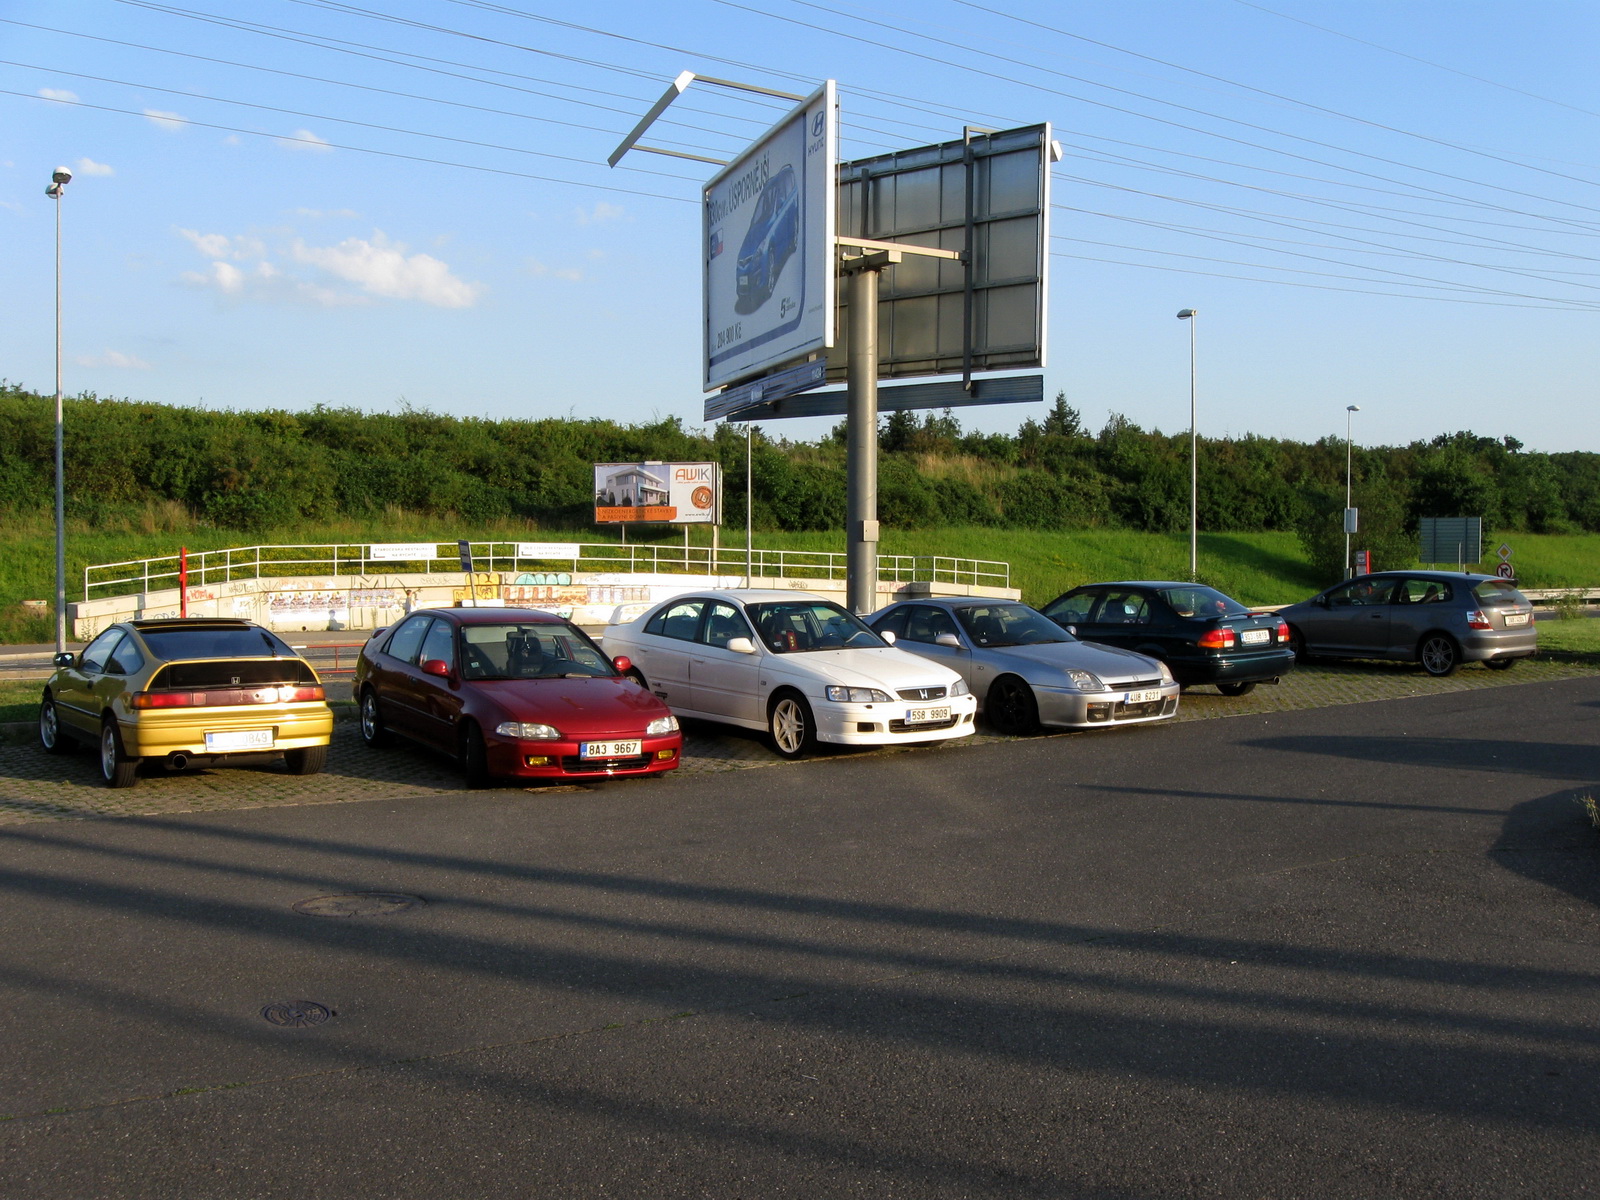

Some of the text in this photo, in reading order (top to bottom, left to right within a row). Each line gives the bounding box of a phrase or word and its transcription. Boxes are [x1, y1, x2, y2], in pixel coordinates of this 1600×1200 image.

[676, 468, 710, 481] AWIK
[912, 708, 948, 720] 5S8 9909
[589, 743, 637, 755] 8A3 9667
